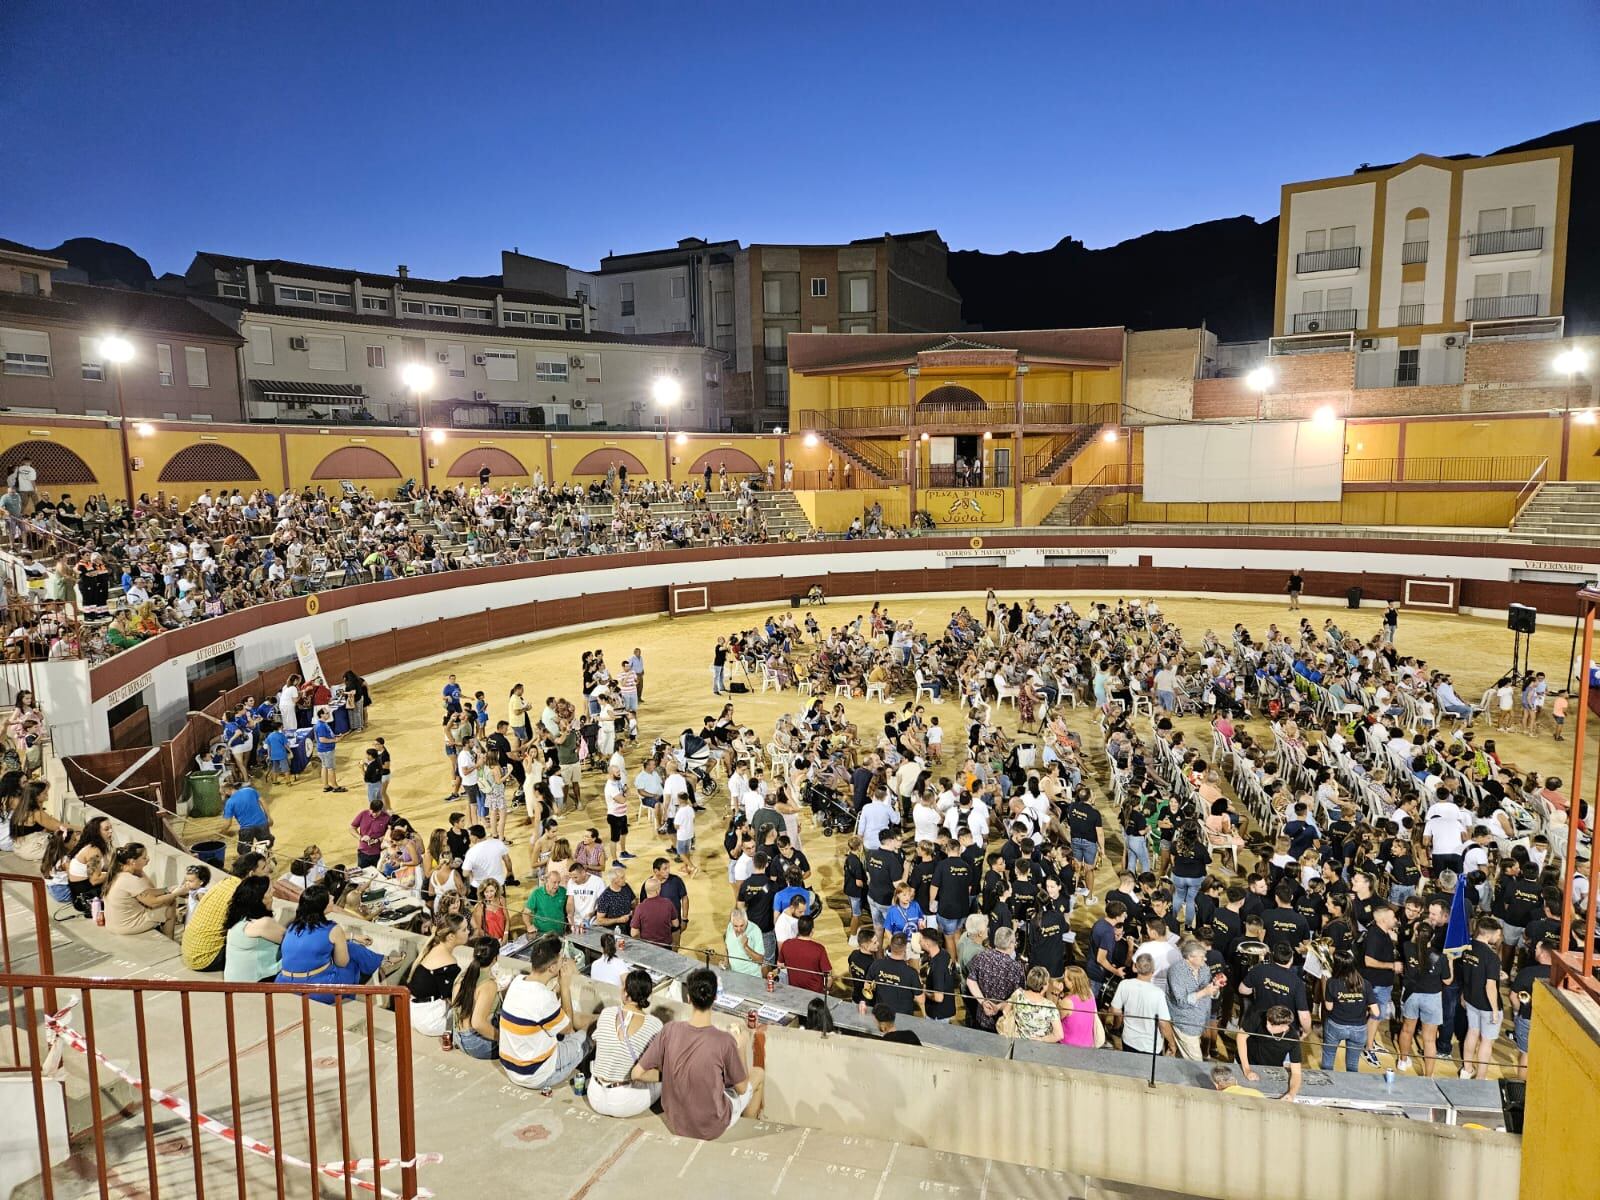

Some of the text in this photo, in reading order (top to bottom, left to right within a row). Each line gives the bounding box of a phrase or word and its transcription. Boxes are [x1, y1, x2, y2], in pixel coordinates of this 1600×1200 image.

[929, 491, 960, 499] PLAZA
[974, 489, 1002, 498] TOROS
[1523, 561, 1585, 572] VETERINARIO
[195, 638, 237, 662] AUTORIDADES
